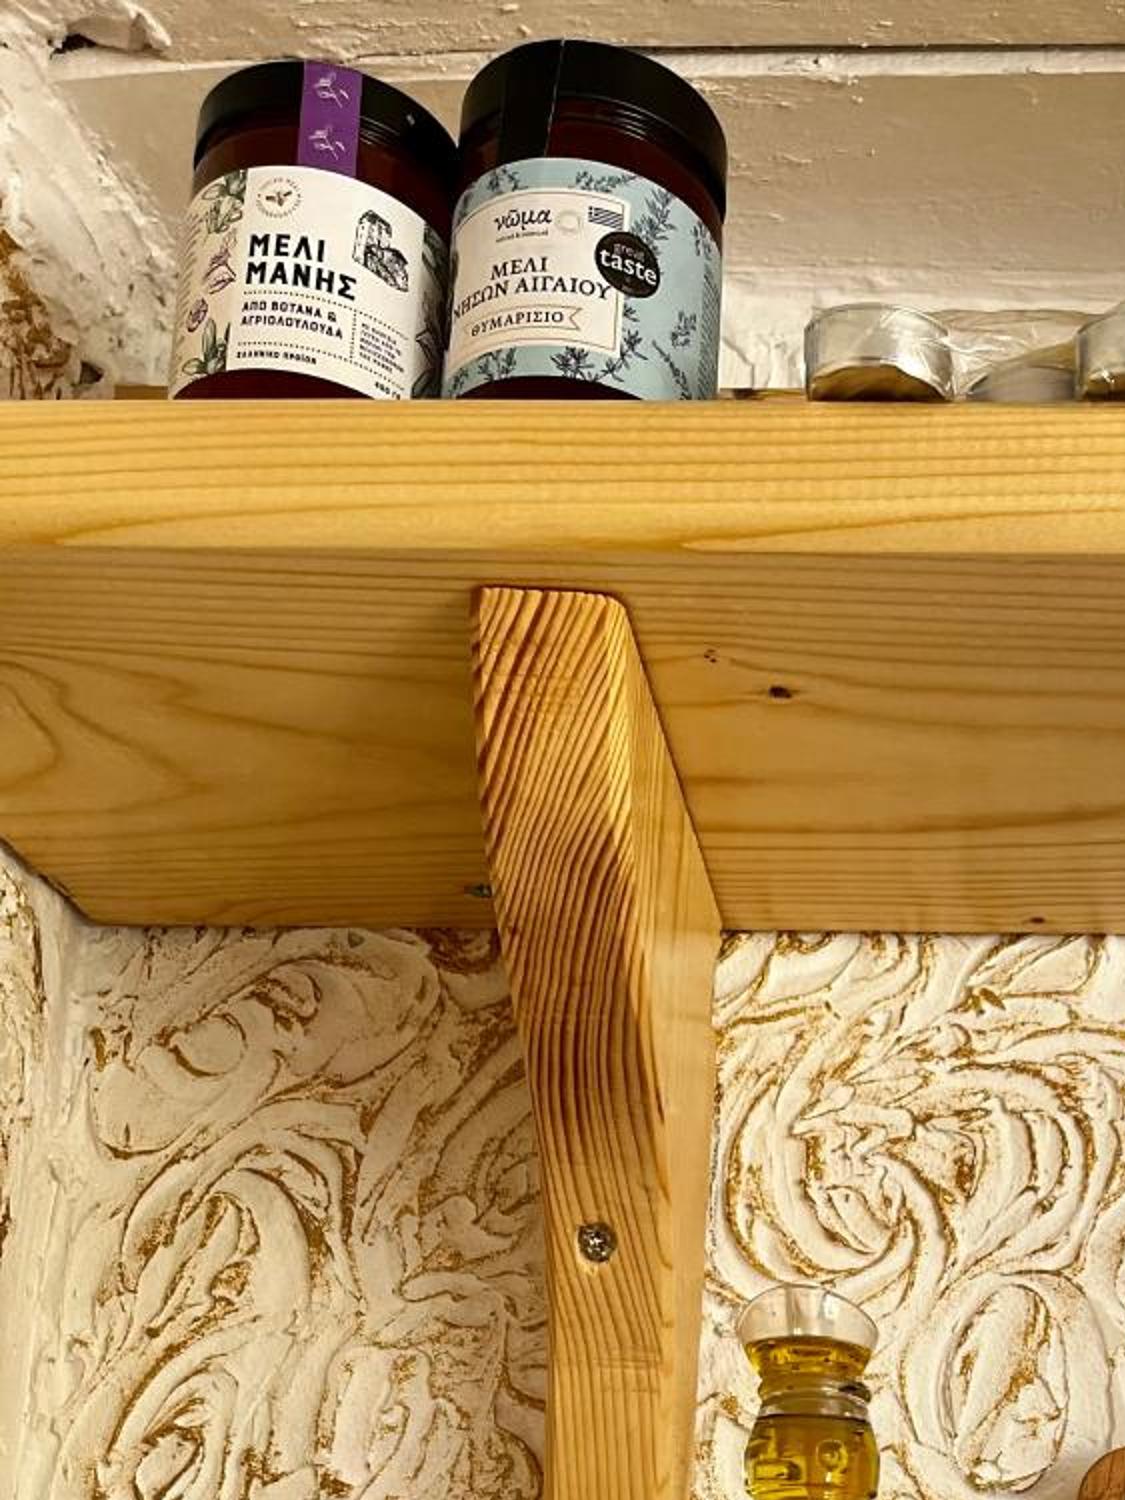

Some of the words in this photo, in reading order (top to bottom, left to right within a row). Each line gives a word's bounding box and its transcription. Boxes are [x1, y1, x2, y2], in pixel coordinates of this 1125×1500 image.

[249, 233, 325, 263] ΜΕΛΙ
[490, 257, 548, 281] ΜΕΛΙ
[600, 249, 657, 286] taste
[245, 261, 357, 301] ΜΑΝΗΣ
[515, 276, 611, 299] ΑΙΓΑΙΟΥ
[242, 301, 267, 312] ΑΠΟ
[271, 301, 322, 319] ΒΟΤΑΝΑ
[471, 311, 564, 337] ΘΥΜΑΡΙΣΙΟ
